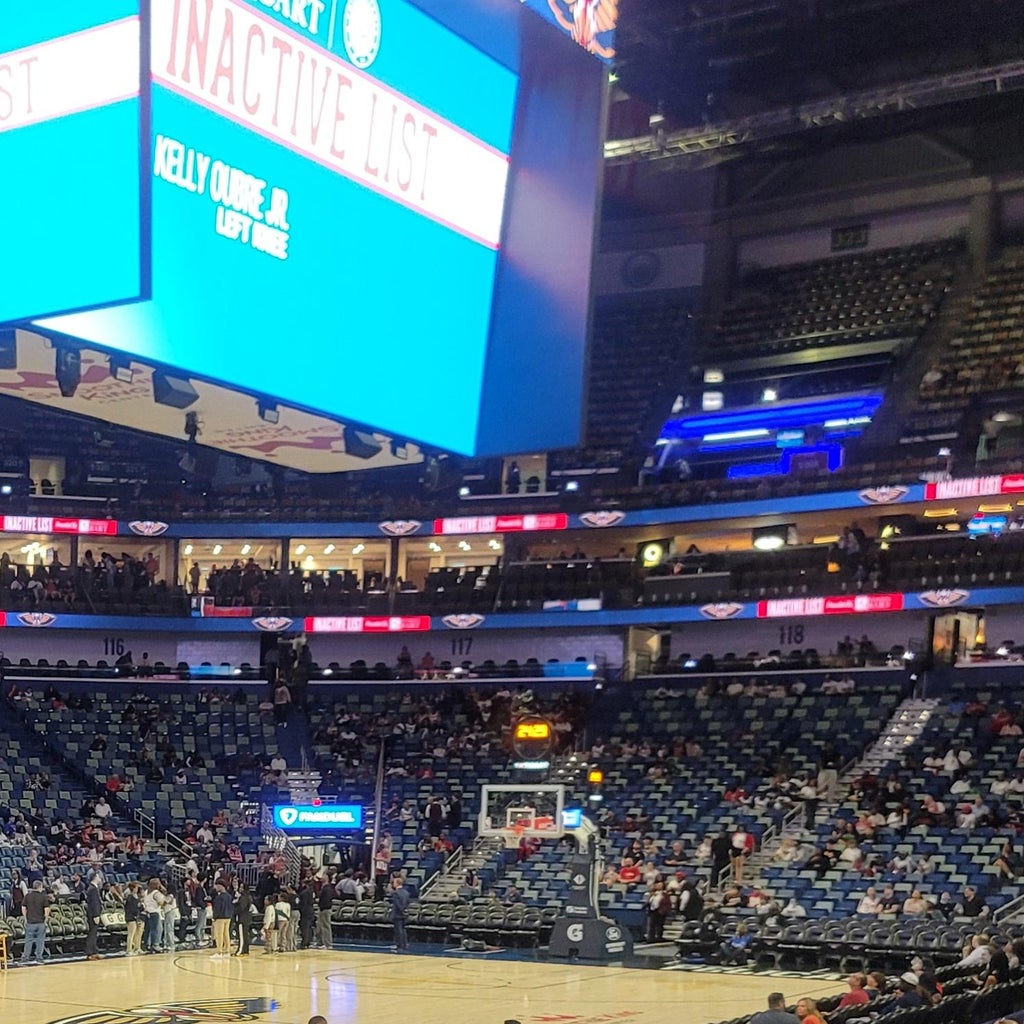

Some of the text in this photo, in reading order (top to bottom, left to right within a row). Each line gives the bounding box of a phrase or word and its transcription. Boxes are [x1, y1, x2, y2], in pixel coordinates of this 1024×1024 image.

[259, 0, 325, 34] ART
[166, 0, 438, 201] INACTIVE LIST
[154, 134, 210, 195] KELLY
[215, 205, 253, 243] LEFT
[103, 637, 125, 655] 116
[449, 637, 473, 655] 117
[779, 625, 804, 645] 118
[566, 923, 584, 942] G
